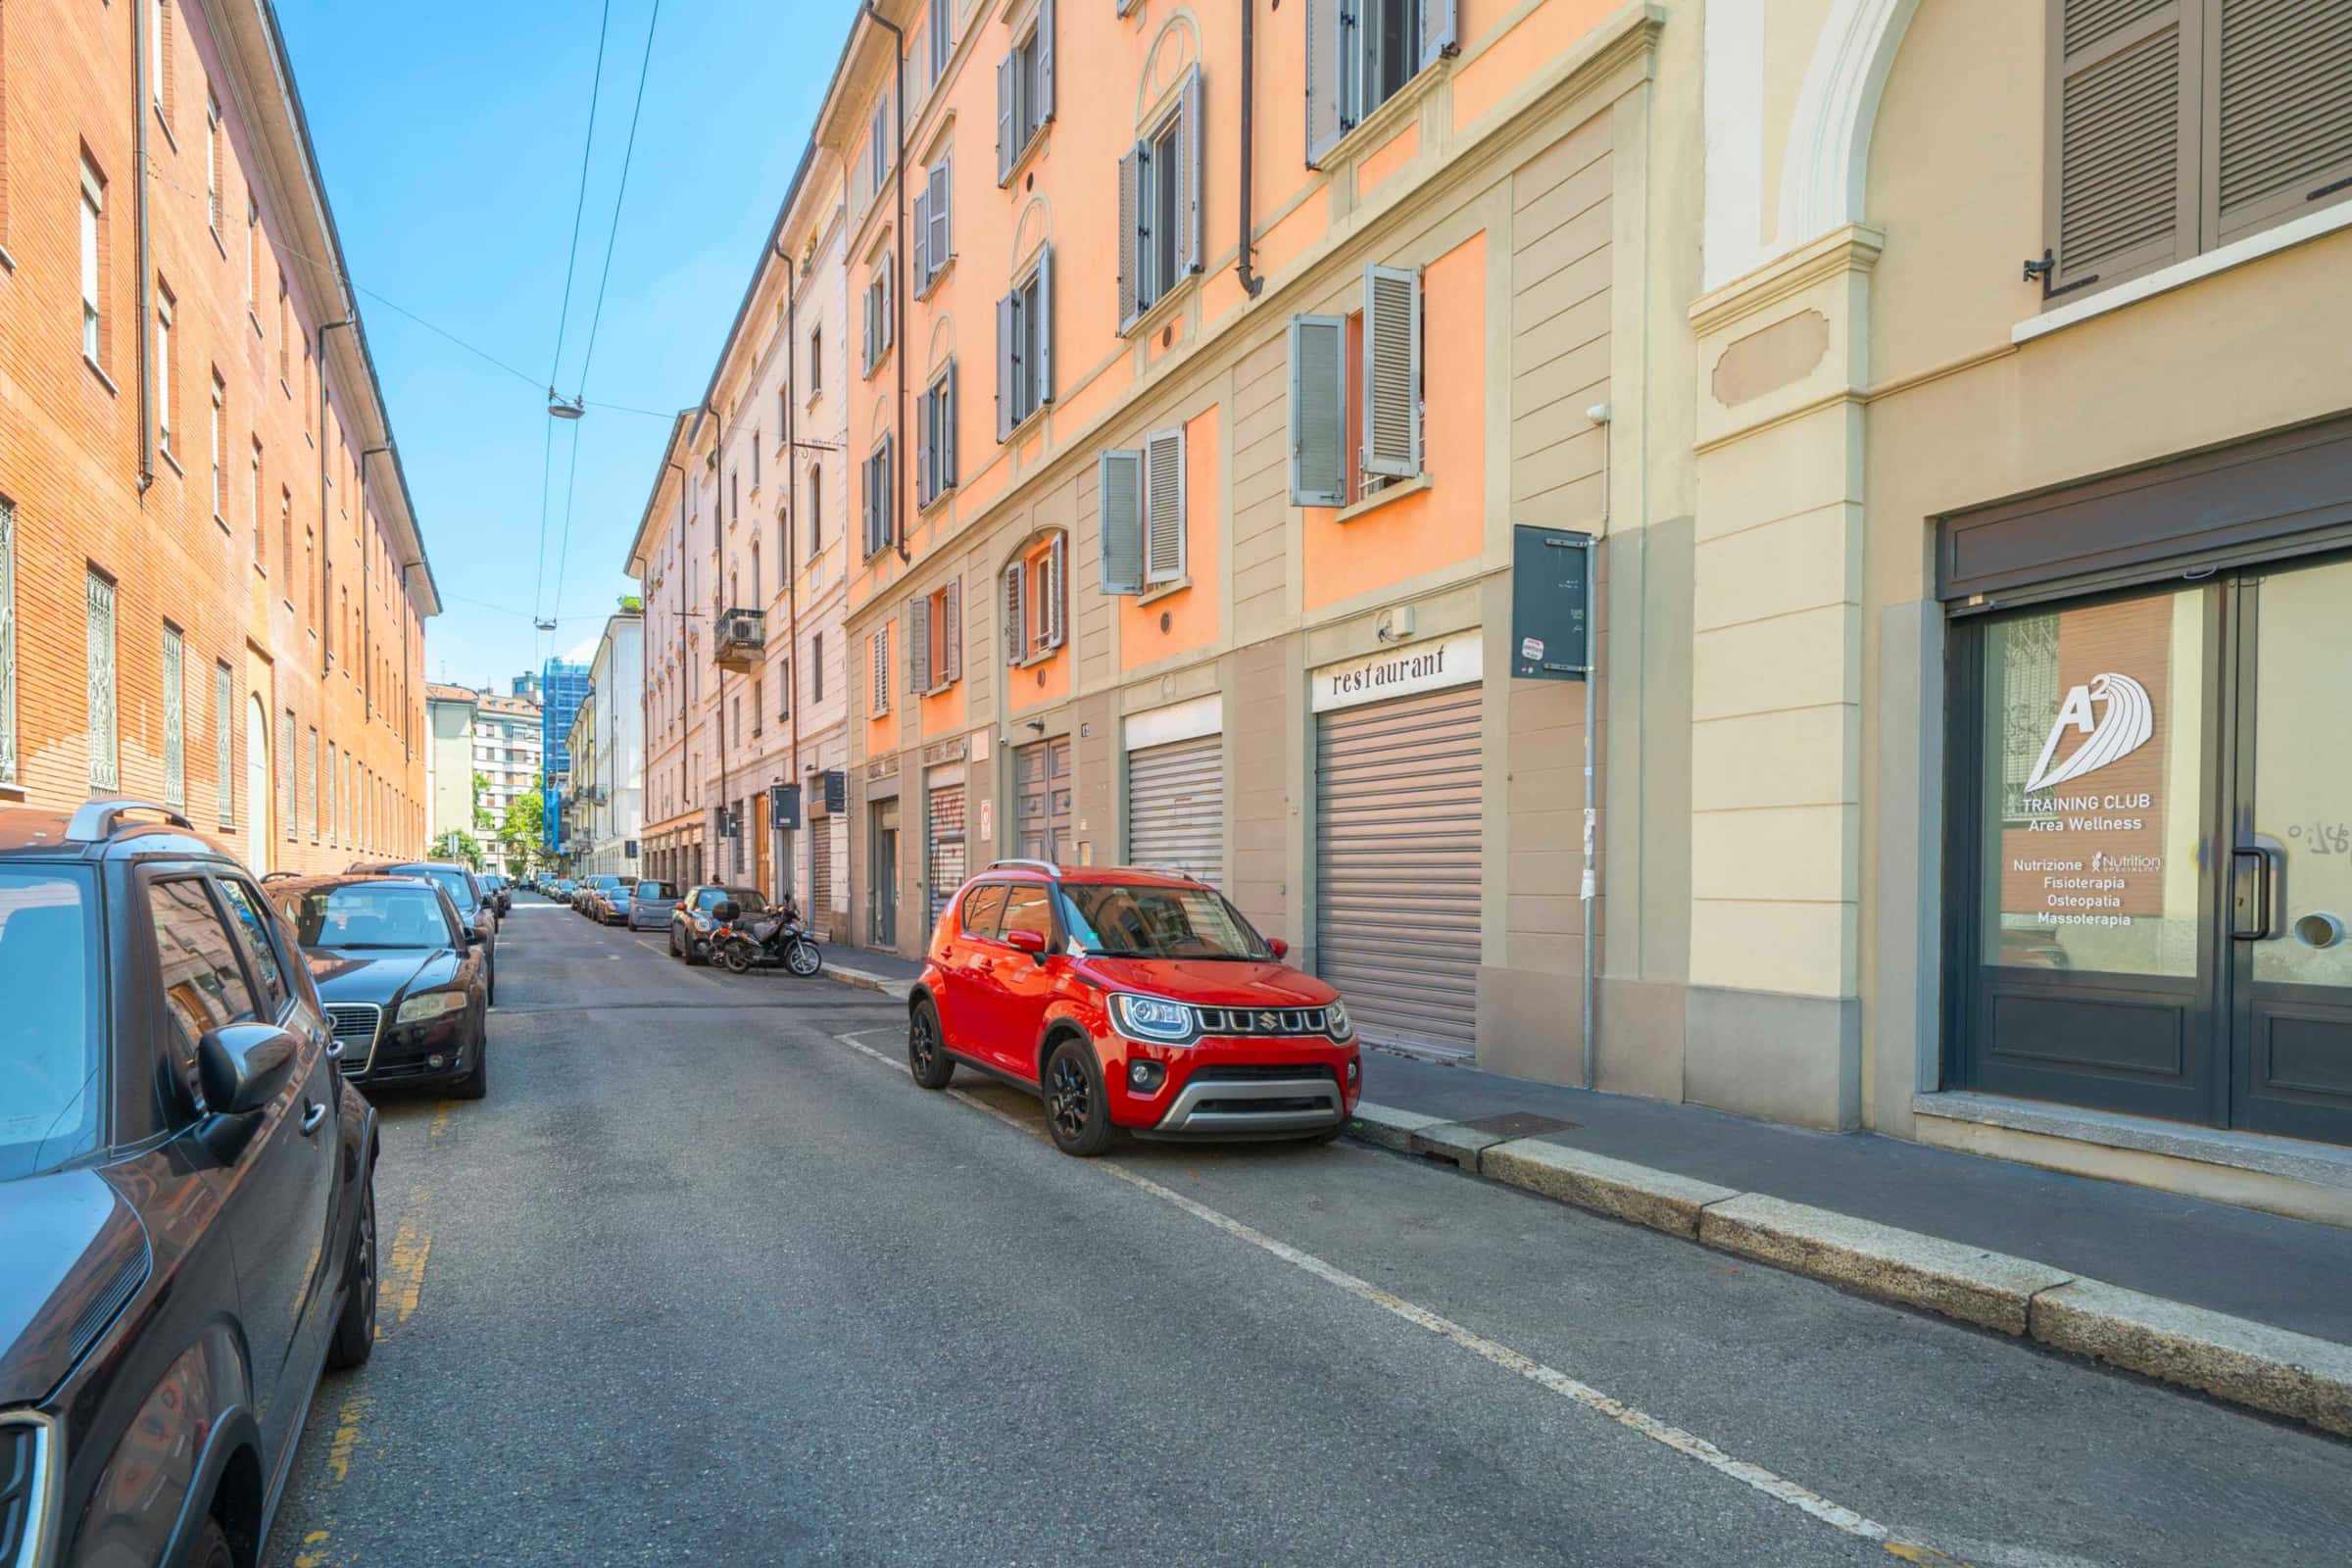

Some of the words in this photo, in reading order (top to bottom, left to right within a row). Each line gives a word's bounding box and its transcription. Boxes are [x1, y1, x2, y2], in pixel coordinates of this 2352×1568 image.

[1333, 645, 1445, 696] restaurant
[2023, 796, 2099, 812] TRAINING
[2104, 794, 2151, 809] CLUB
[2029, 819, 2064, 832] Area
[2069, 817, 2142, 831] Wellness
[2013, 858, 2082, 871] Nutrizione
[2102, 855, 2161, 867] Nutrition
[2043, 876, 2126, 891] Fisioterapia
[2047, 894, 2121, 909] Osteopatia
[2037, 911, 2132, 928] Massoterapia
